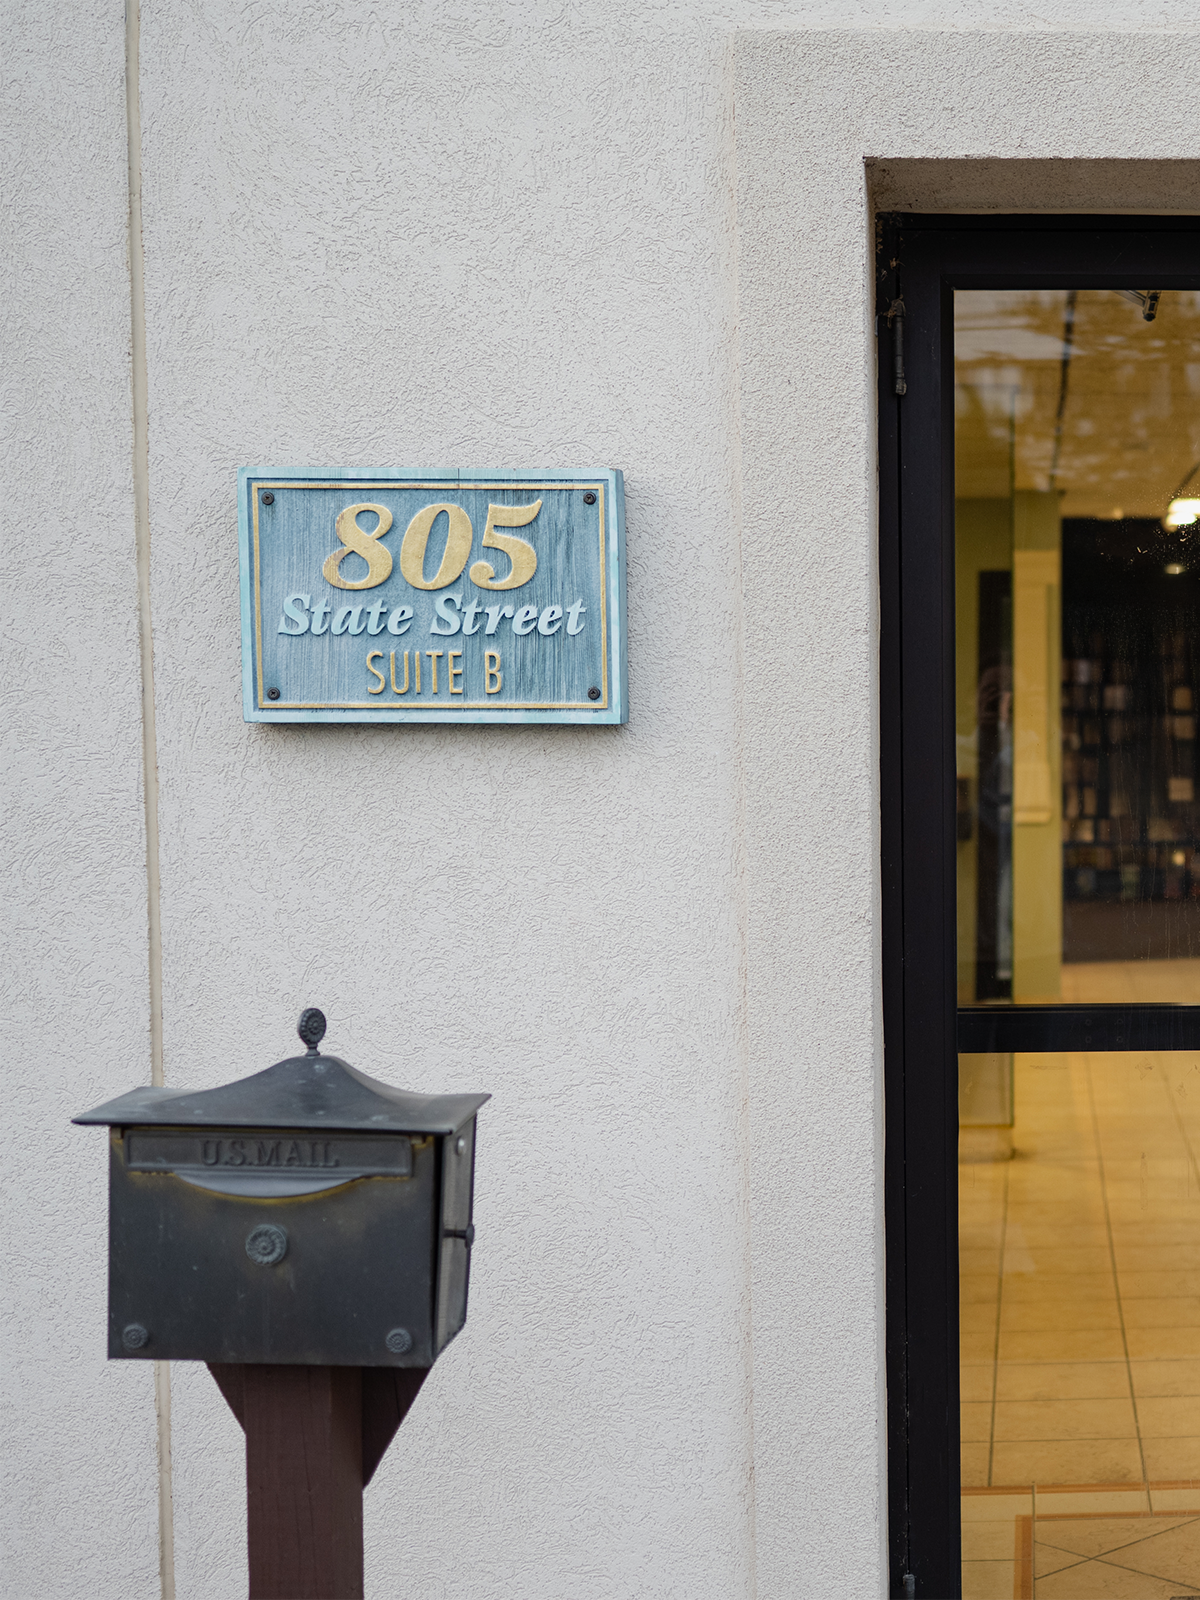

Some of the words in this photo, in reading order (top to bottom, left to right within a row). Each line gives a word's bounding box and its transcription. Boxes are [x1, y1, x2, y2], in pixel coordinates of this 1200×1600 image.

[322, 499, 543, 590] 805
[278, 593, 414, 636] State
[430, 593, 587, 636] Street
[366, 650, 463, 695] SUITE
[484, 651, 502, 695] B
